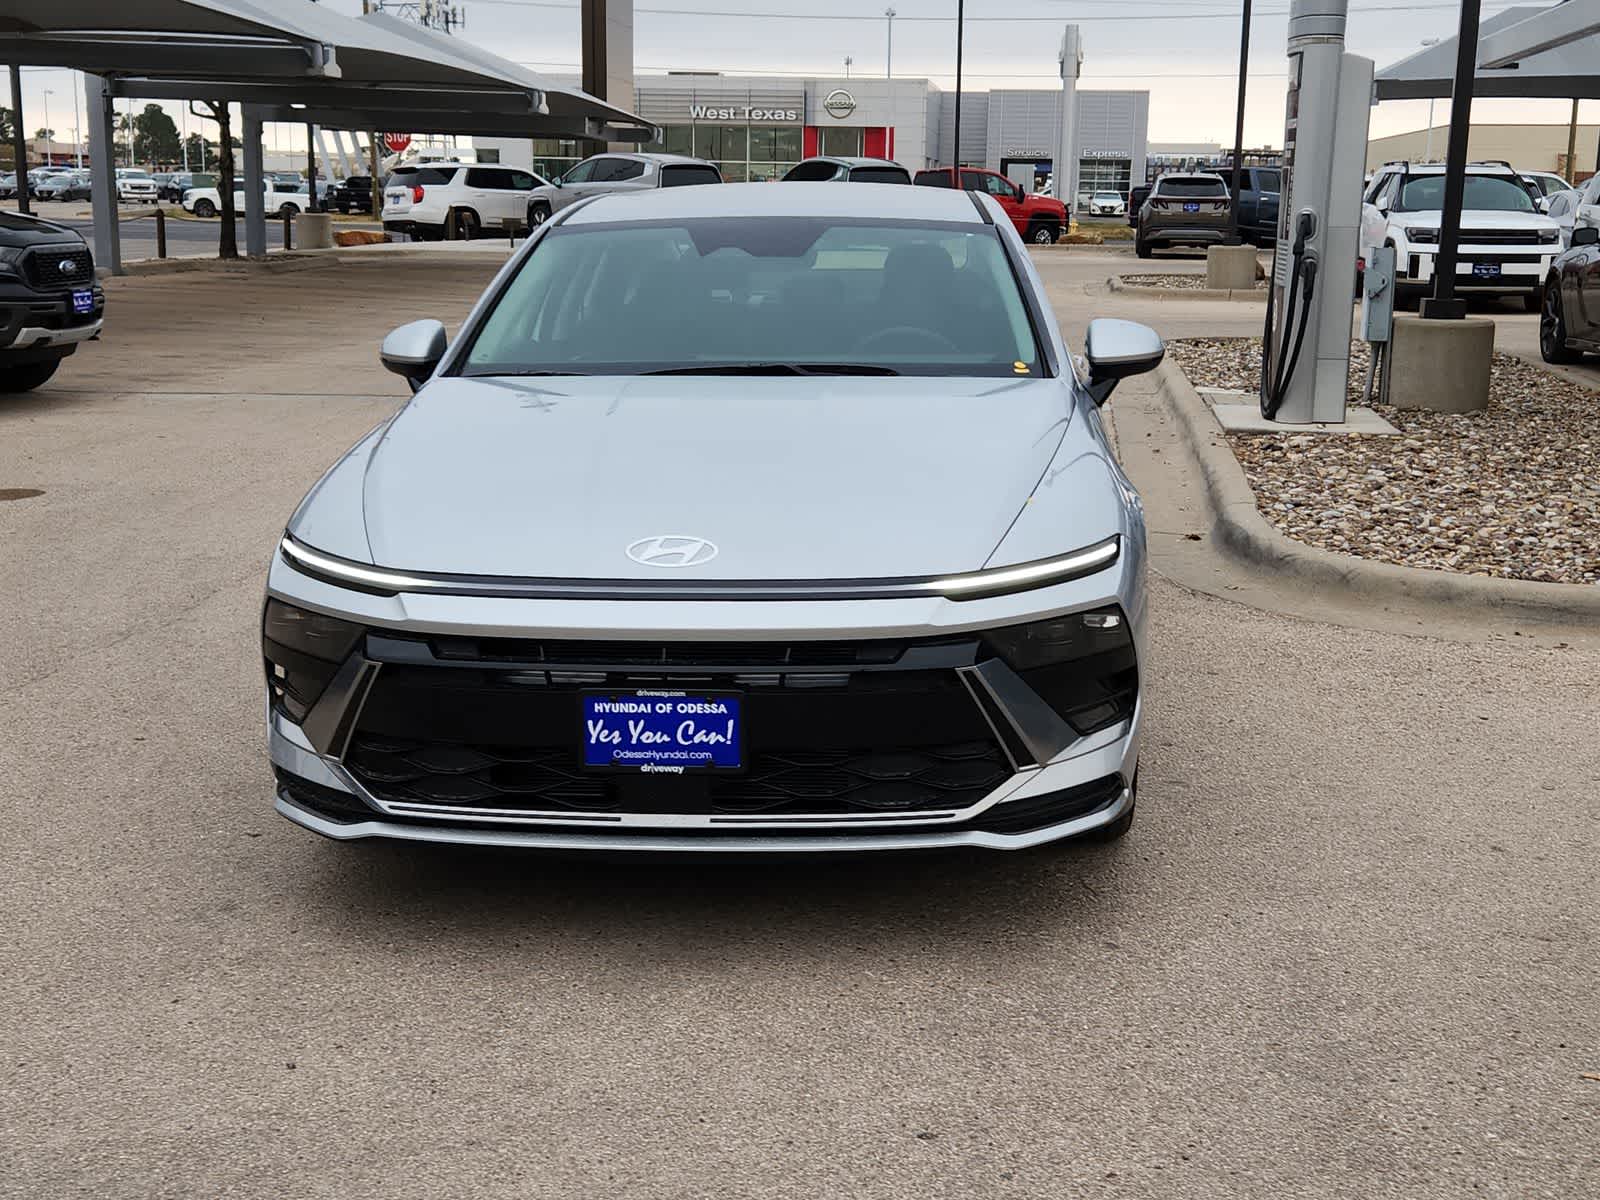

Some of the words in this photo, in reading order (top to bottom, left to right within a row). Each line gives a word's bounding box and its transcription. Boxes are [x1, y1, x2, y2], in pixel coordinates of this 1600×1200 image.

[689, 106, 736, 120] West
[741, 106, 797, 121] Texas
[386, 132, 410, 142] STOP
[636, 689, 687, 698] driveway.com
[594, 702, 651, 714] HYUNDAI
[655, 702, 673, 714] OF
[676, 703, 728, 714] ODESSA
[586, 719, 622, 744] Yes
[627, 719, 671, 744] You
[676, 719, 734, 745] Can!
[613, 749, 713, 760] OdessaHyundai.com
[640, 762, 685, 774] driveway
